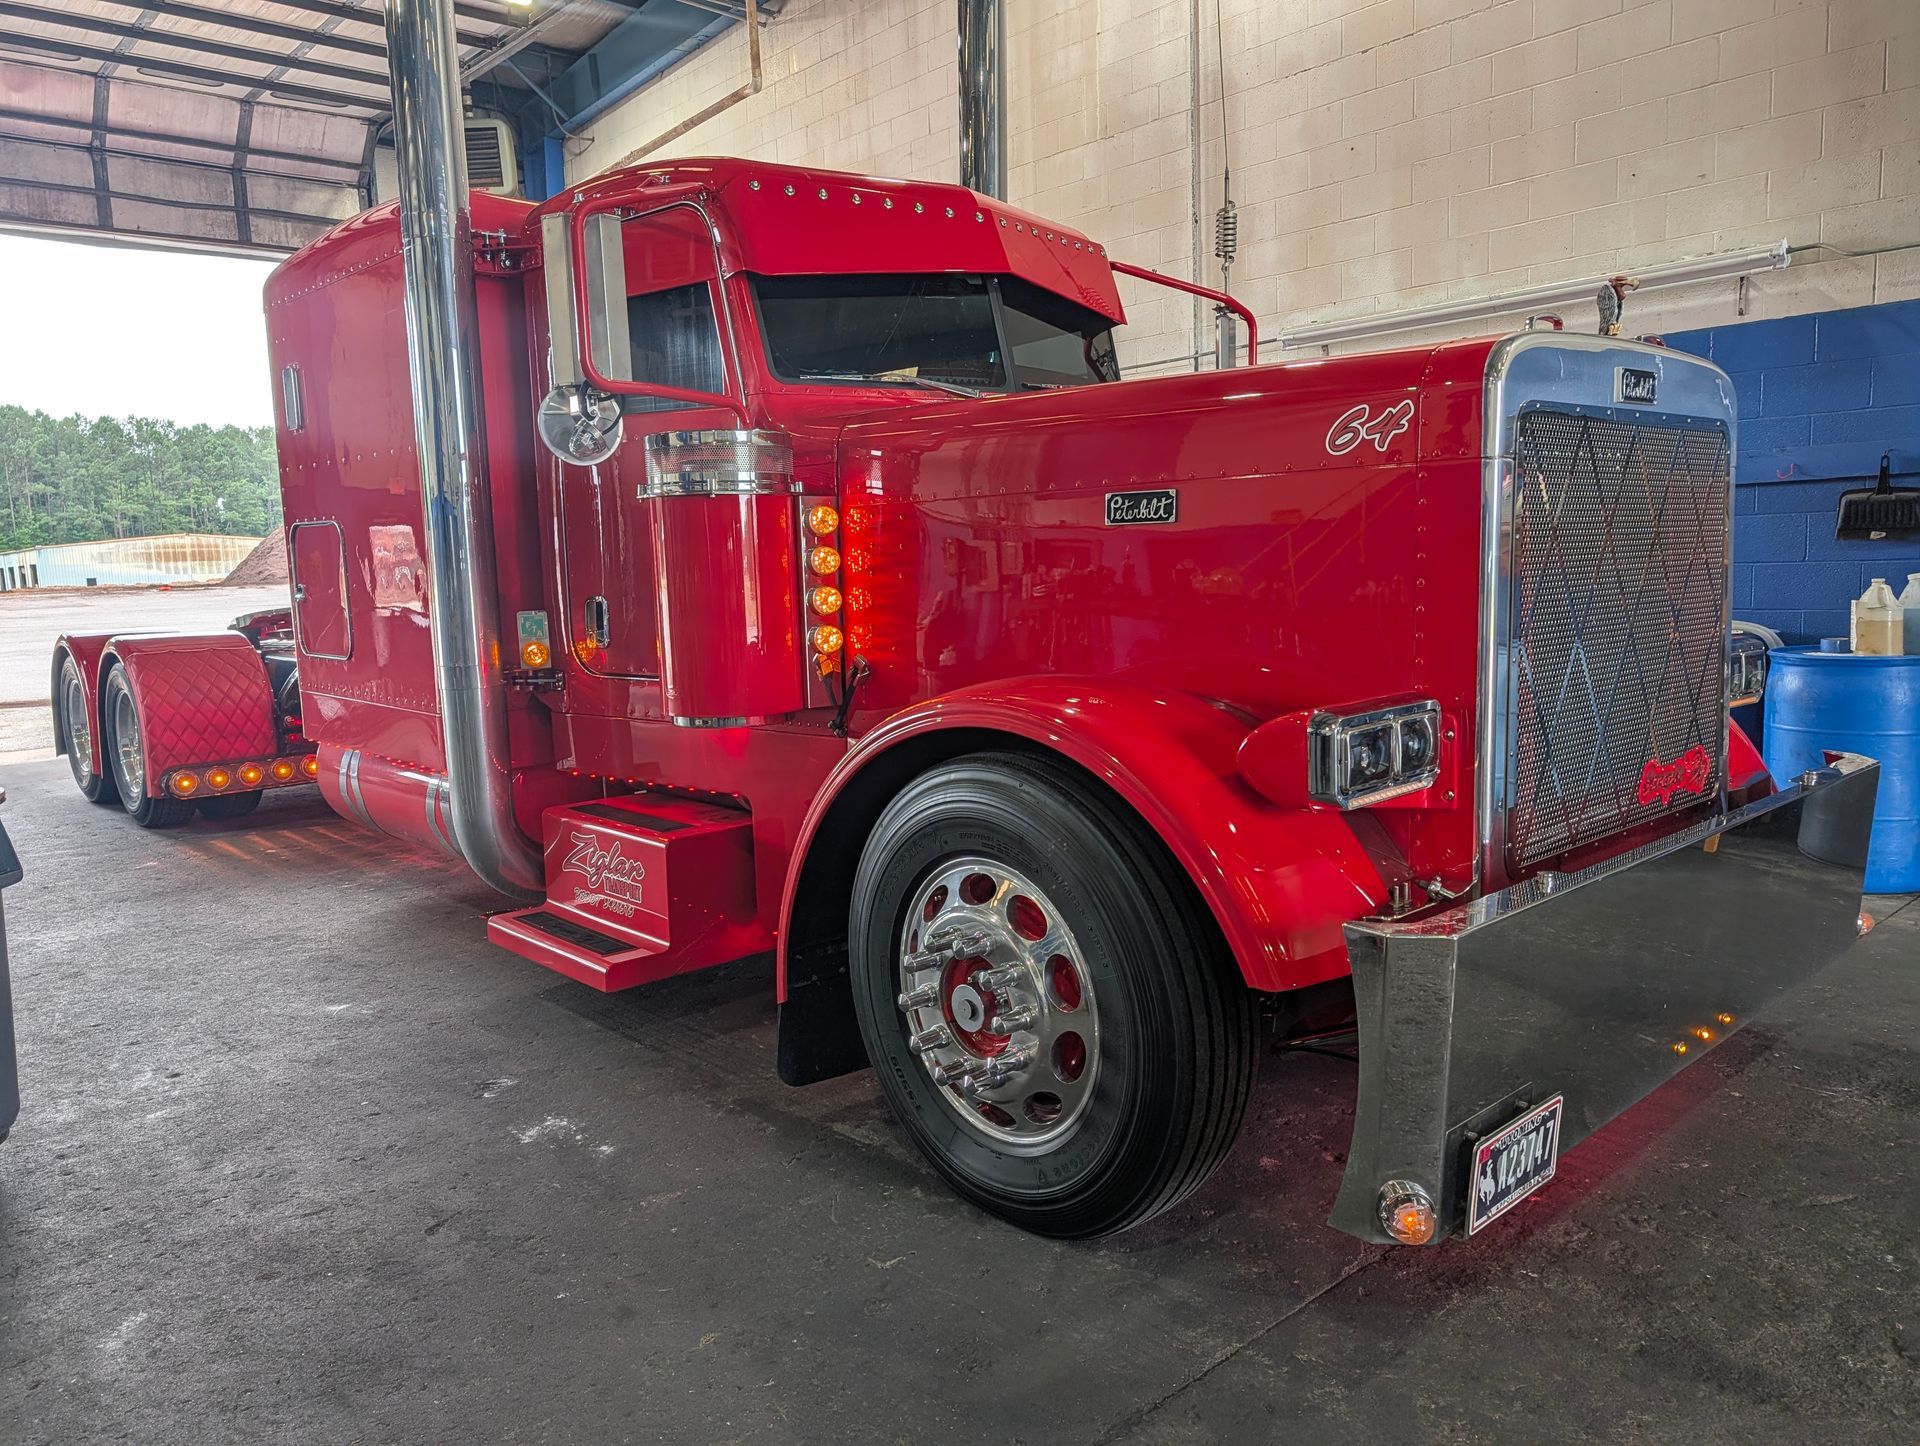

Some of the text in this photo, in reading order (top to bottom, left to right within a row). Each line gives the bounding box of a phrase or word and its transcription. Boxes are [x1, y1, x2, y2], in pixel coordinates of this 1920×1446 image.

[1325, 399, 1415, 456] 64
[1110, 496, 1173, 521] Peterbilt
[562, 831, 645, 889] Ziglar
[1497, 1119, 1555, 1193] A23747
[1500, 1113, 1543, 1150] WYOMING
